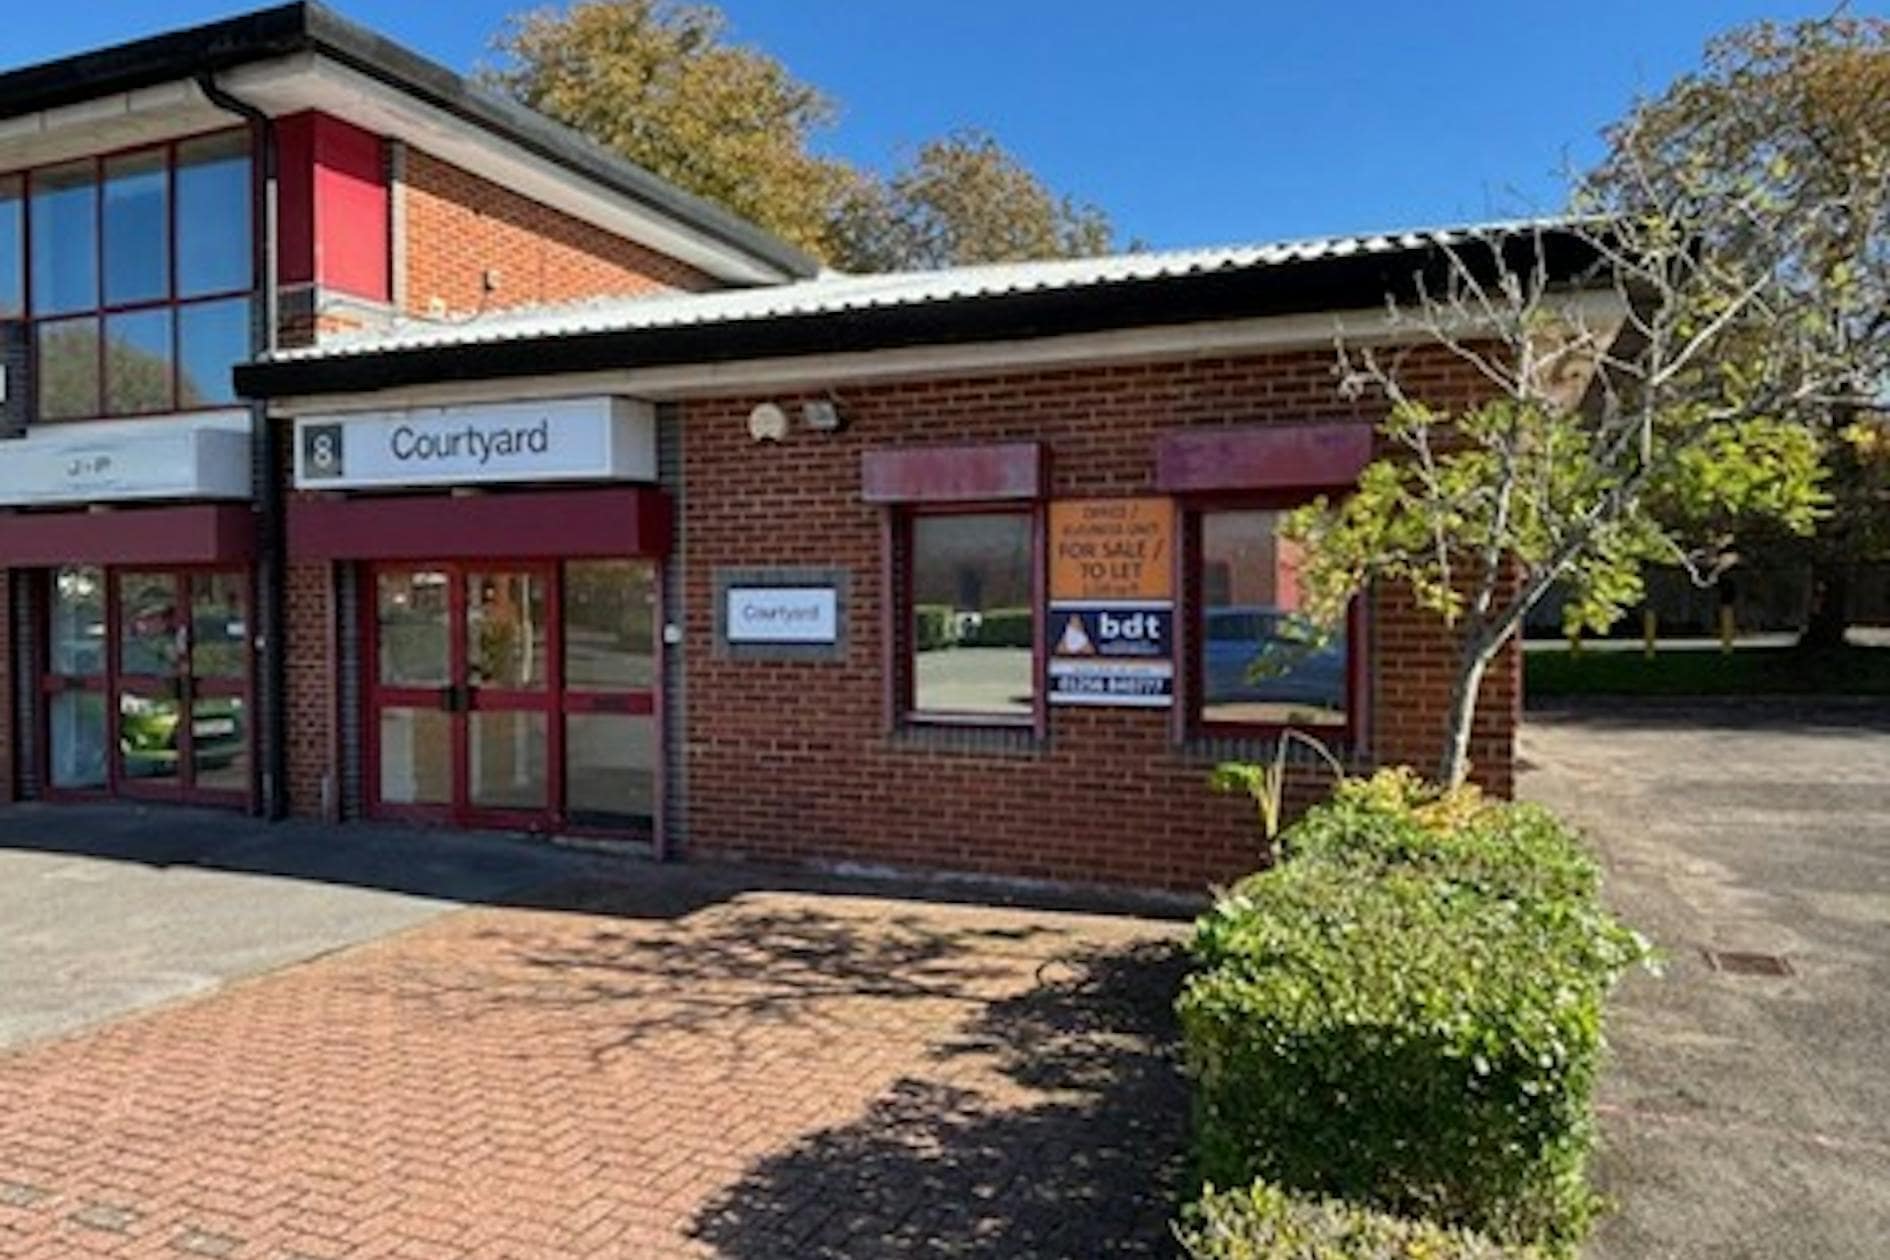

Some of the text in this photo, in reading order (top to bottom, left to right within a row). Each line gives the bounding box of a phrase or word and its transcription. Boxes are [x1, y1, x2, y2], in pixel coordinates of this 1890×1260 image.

[313, 434, 333, 468] 8
[391, 417, 548, 465] Courtyard
[1059, 541, 1095, 559] FOR
[1102, 540, 1146, 559] SALE
[1080, 561, 1142, 579] TO LET
[741, 603, 820, 625] Courtyard
[1100, 611, 1160, 640] bdt
